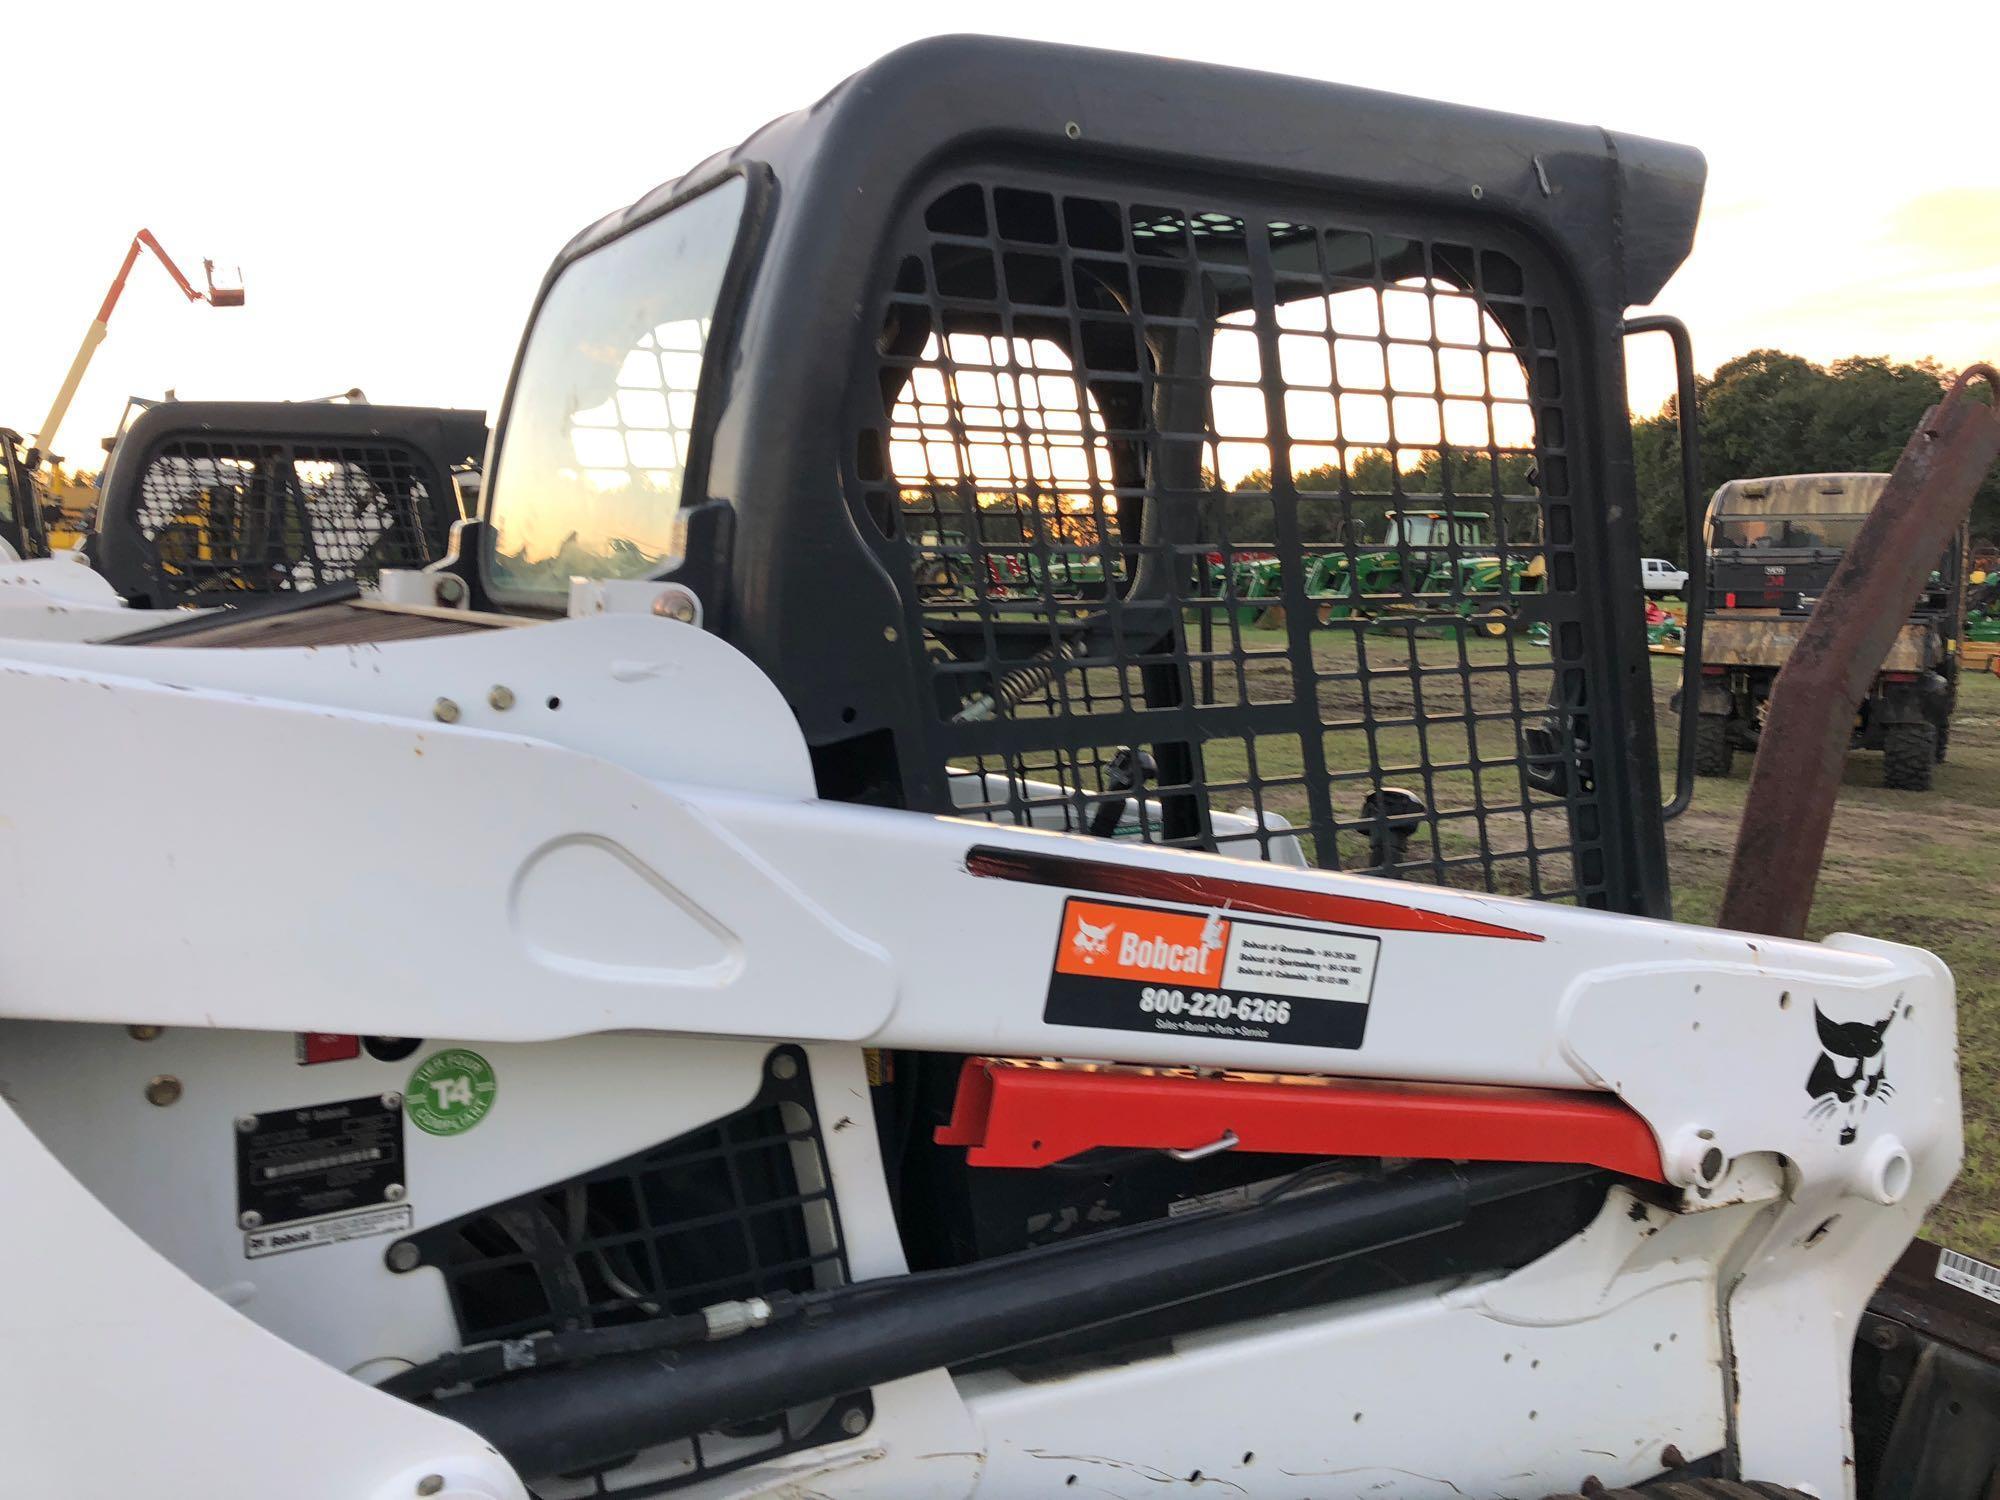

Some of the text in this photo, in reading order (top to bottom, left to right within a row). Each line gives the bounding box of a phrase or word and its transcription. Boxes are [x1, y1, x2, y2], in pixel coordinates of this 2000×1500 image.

[1118, 932, 1210, 975] Bobcat
[1139, 987, 1291, 1025] 800-220-6266
[429, 1075, 474, 1110] T4
